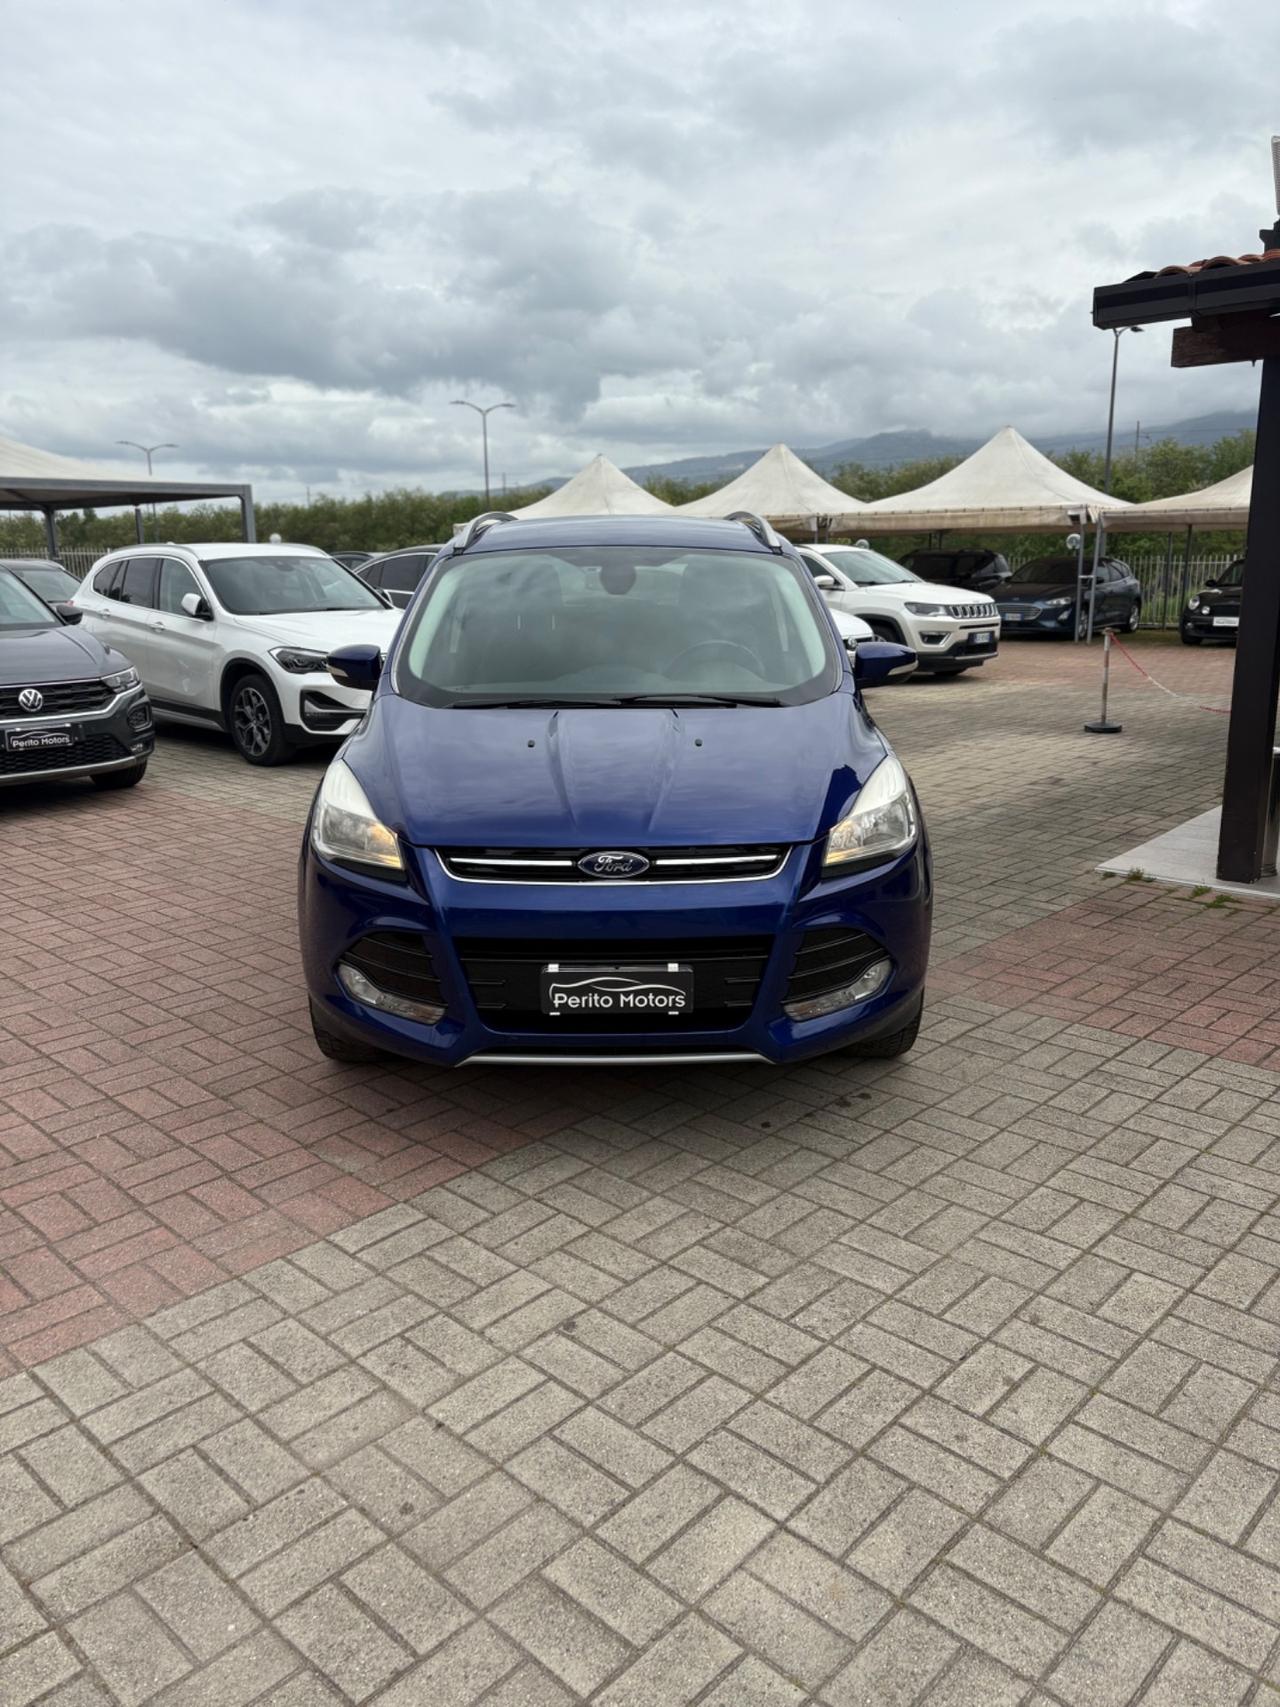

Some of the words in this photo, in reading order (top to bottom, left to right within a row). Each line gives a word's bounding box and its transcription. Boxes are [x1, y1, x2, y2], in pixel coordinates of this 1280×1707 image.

[12, 739, 40, 748] Perito
[41, 735, 70, 745] Motors
[594, 855, 633, 872] Ford
[553, 993, 613, 1009] Perito
[619, 993, 686, 1009] Motors
